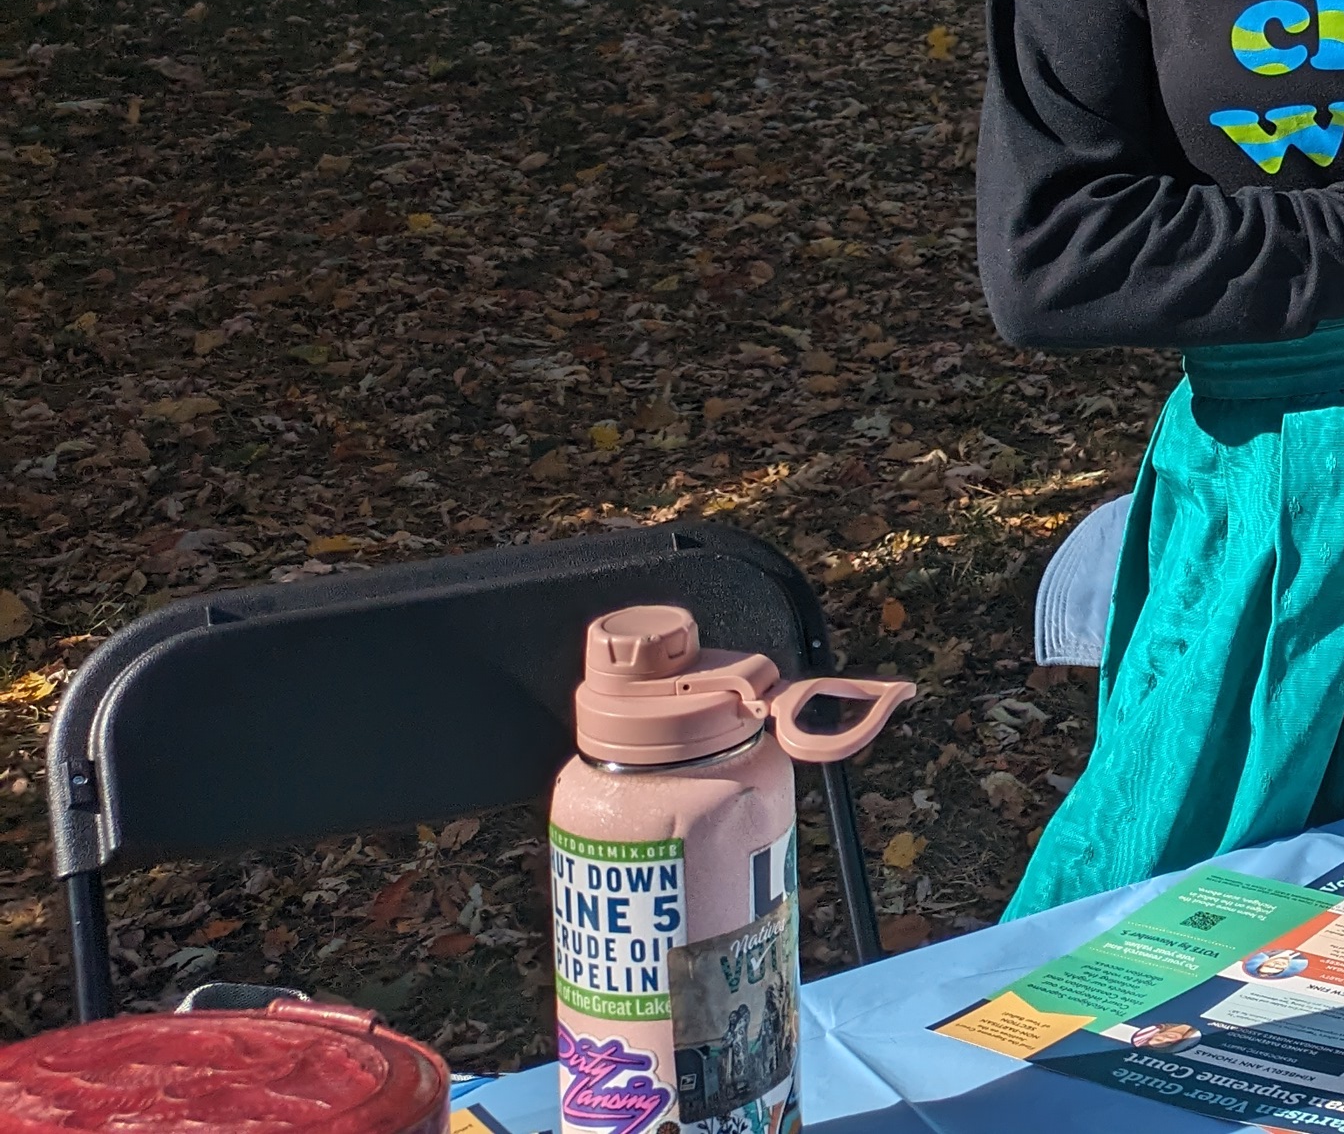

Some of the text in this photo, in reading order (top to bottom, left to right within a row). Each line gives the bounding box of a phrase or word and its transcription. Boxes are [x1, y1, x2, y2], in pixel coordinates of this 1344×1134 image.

[551, 827, 678, 859] terDontMix.org
[552, 851, 678, 892] UT DOWN
[553, 877, 681, 934] LINE 5
[556, 918, 617, 962] CRUDE
[730, 918, 786, 959] Natives
[1126, 930, 1178, 947] November
[1151, 946, 1179, 956] your
[1174, 942, 1194, 950] by
[1187, 946, 1223, 958] VOTE
[557, 947, 659, 992] PIPELIN
[1100, 942, 1200, 970] Do your research and
[1173, 953, 1198, 961] vote
[563, 985, 571, 1002] of
[572, 989, 590, 1010] the
[592, 995, 632, 1016] Great
[636, 998, 672, 1016] Lake
[1303, 983, 1333, 992] FINK
[559, 1028, 645, 1087] Dirty
[1123, 1053, 1195, 1079] Court
[1190, 1049, 1319, 1081] KIMBERLY ANN THOMAS
[1112, 1068, 1183, 1095] Guide
[1195, 1071, 1307, 1105] Supreme
[564, 1077, 661, 1134] Lansing
[1182, 1088, 1251, 1114] Voter
